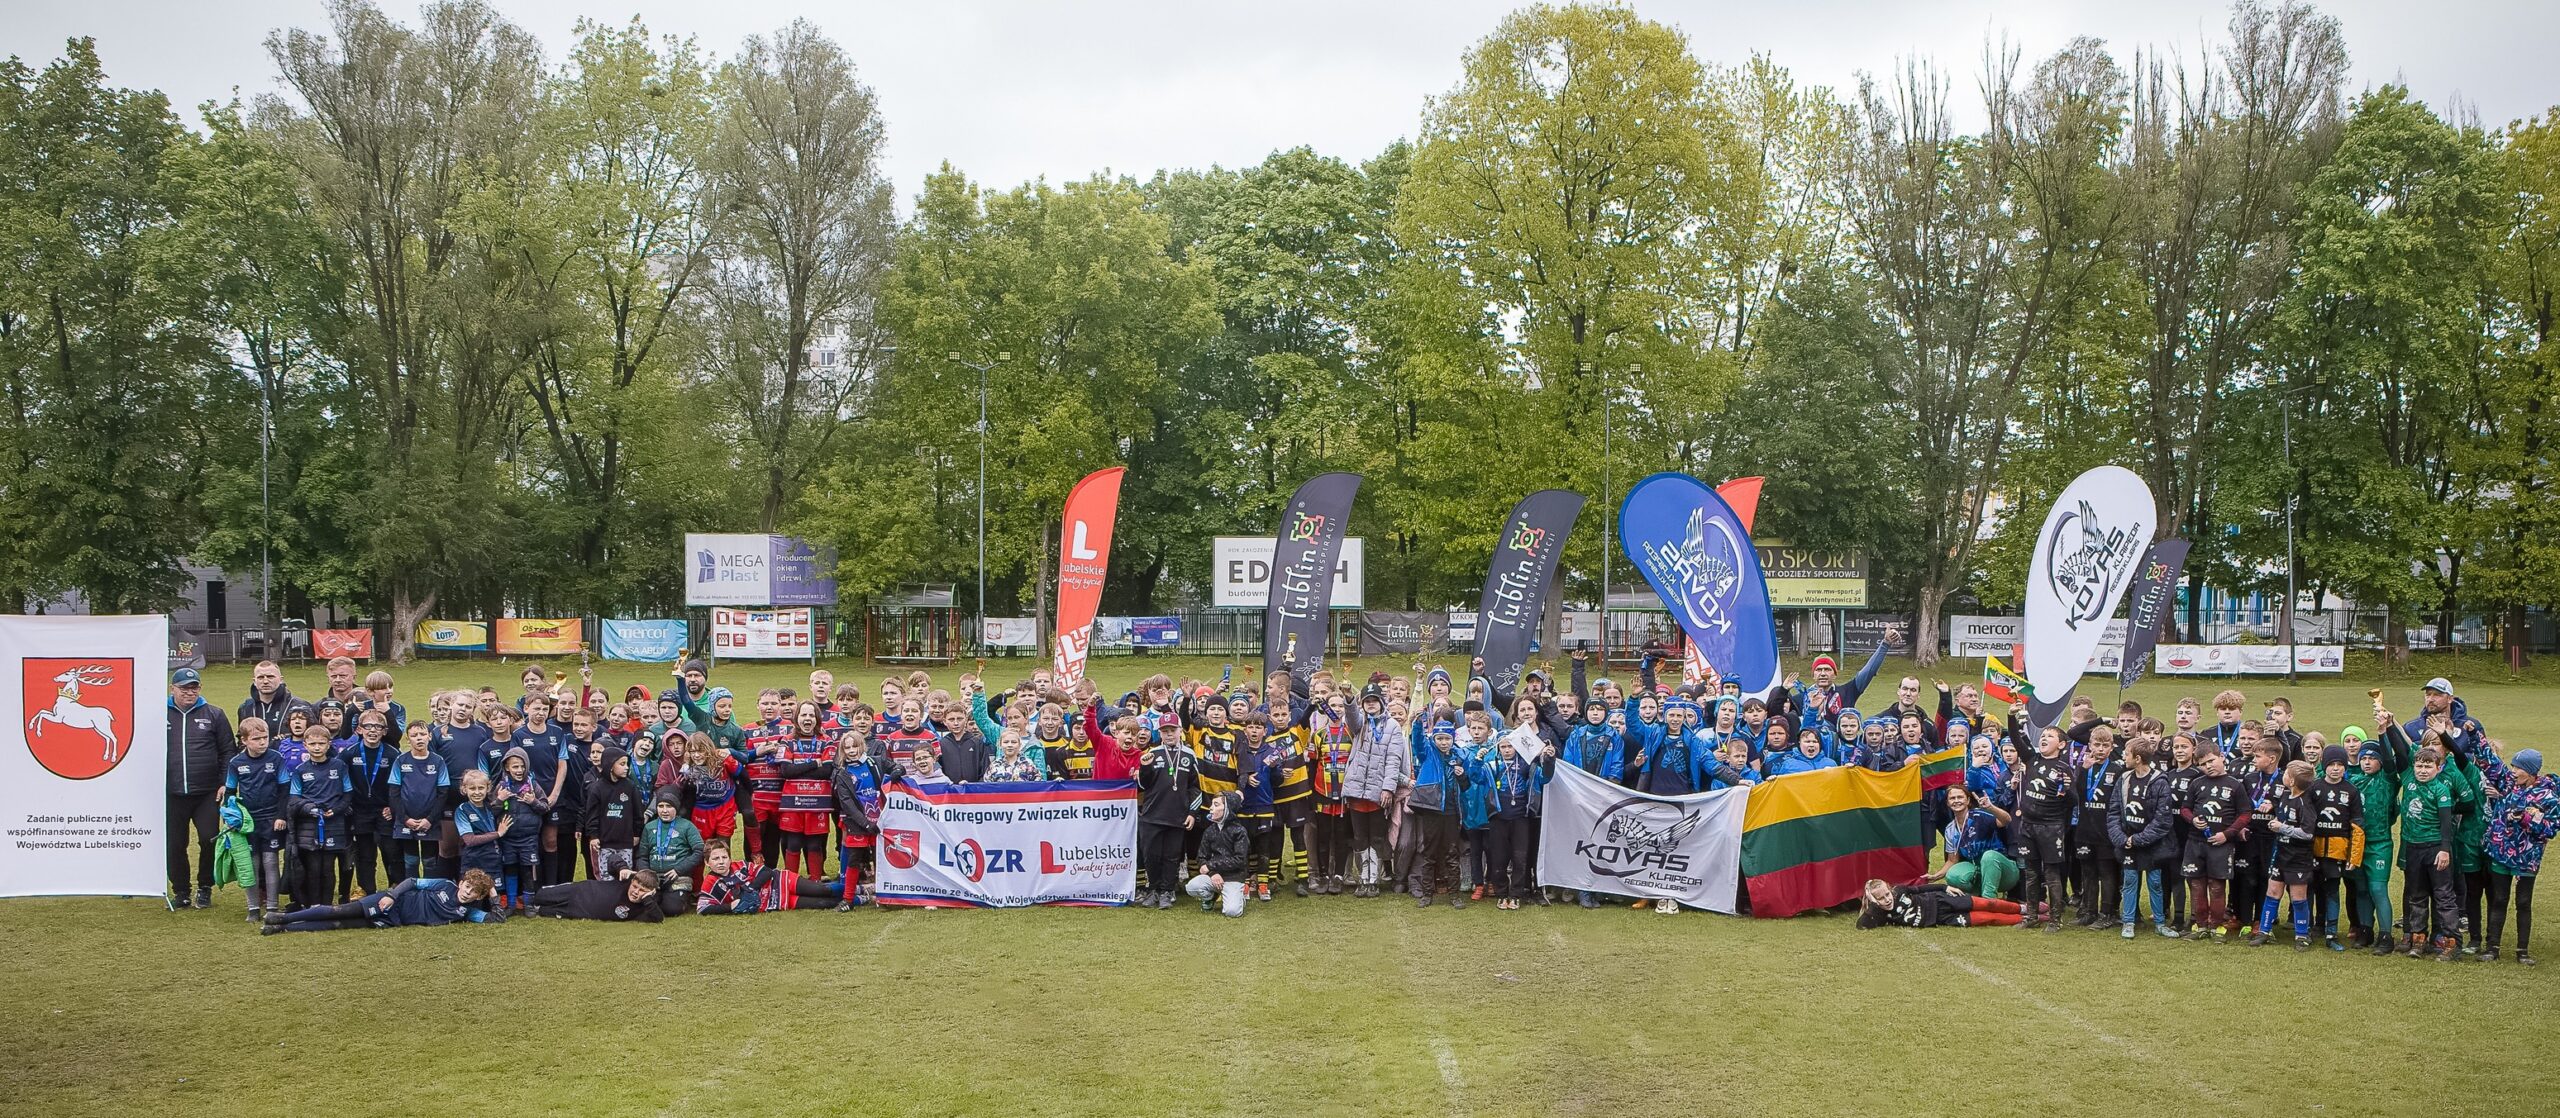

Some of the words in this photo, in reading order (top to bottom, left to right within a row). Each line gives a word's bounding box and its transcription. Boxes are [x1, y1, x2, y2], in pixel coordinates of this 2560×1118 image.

[1071, 520, 1098, 560] L
[721, 554, 764, 568] MEGA
[776, 554, 816, 562] Producent
[1228, 560, 1348, 583] EDH
[1311, 582, 1322, 621] MIASTO
[1317, 517, 1336, 576] INSPIRACJI
[2109, 567, 2125, 593] REGBIO
[2123, 539, 2140, 568] KLUBAS
[721, 569, 759, 582] Plast
[1777, 569, 1812, 578] ODZIEŻY
[1814, 570, 1860, 578] SPORTOWEJ
[2065, 526, 2125, 631] KOVAS
[1519, 592, 1535, 629] MIASTO
[1532, 532, 1555, 588] INSPIRACJI
[1845, 618, 1909, 630] aliplast
[1968, 624, 2016, 635] mercor
[436, 631, 454, 640] LOTTO
[619, 628, 669, 639] mercor
[642, 646, 669, 655] ABLOY
[2025, 789, 2046, 801] ORLEN
[27, 815, 65, 823] Zadanie
[67, 815, 112, 824] publiczne
[115, 815, 132, 824] jest
[944, 808, 1013, 824] Okręgowy
[1018, 806, 1078, 822] Związek
[1082, 804, 1128, 821] Rugby
[2126, 816, 2145, 824] RLEN
[2317, 821, 2342, 829] ORLEN
[7, 827, 95, 837] współfinansowane
[111, 827, 152, 836] środków
[16, 841, 81, 850] Województwa
[84, 841, 142, 850] Lubelskiego
[1040, 840, 1066, 874] L
[1059, 844, 1131, 861] lubelskie
[1574, 840, 1690, 872] KOVAS
[1070, 861, 1104, 879] Smakuj
[1105, 860, 1132, 877] życie!
[1624, 878, 1654, 888] REGBIO
[1655, 882, 1688, 892] KLUBAS
[883, 881, 947, 895] Finansowane
[964, 890, 1003, 905] środków
